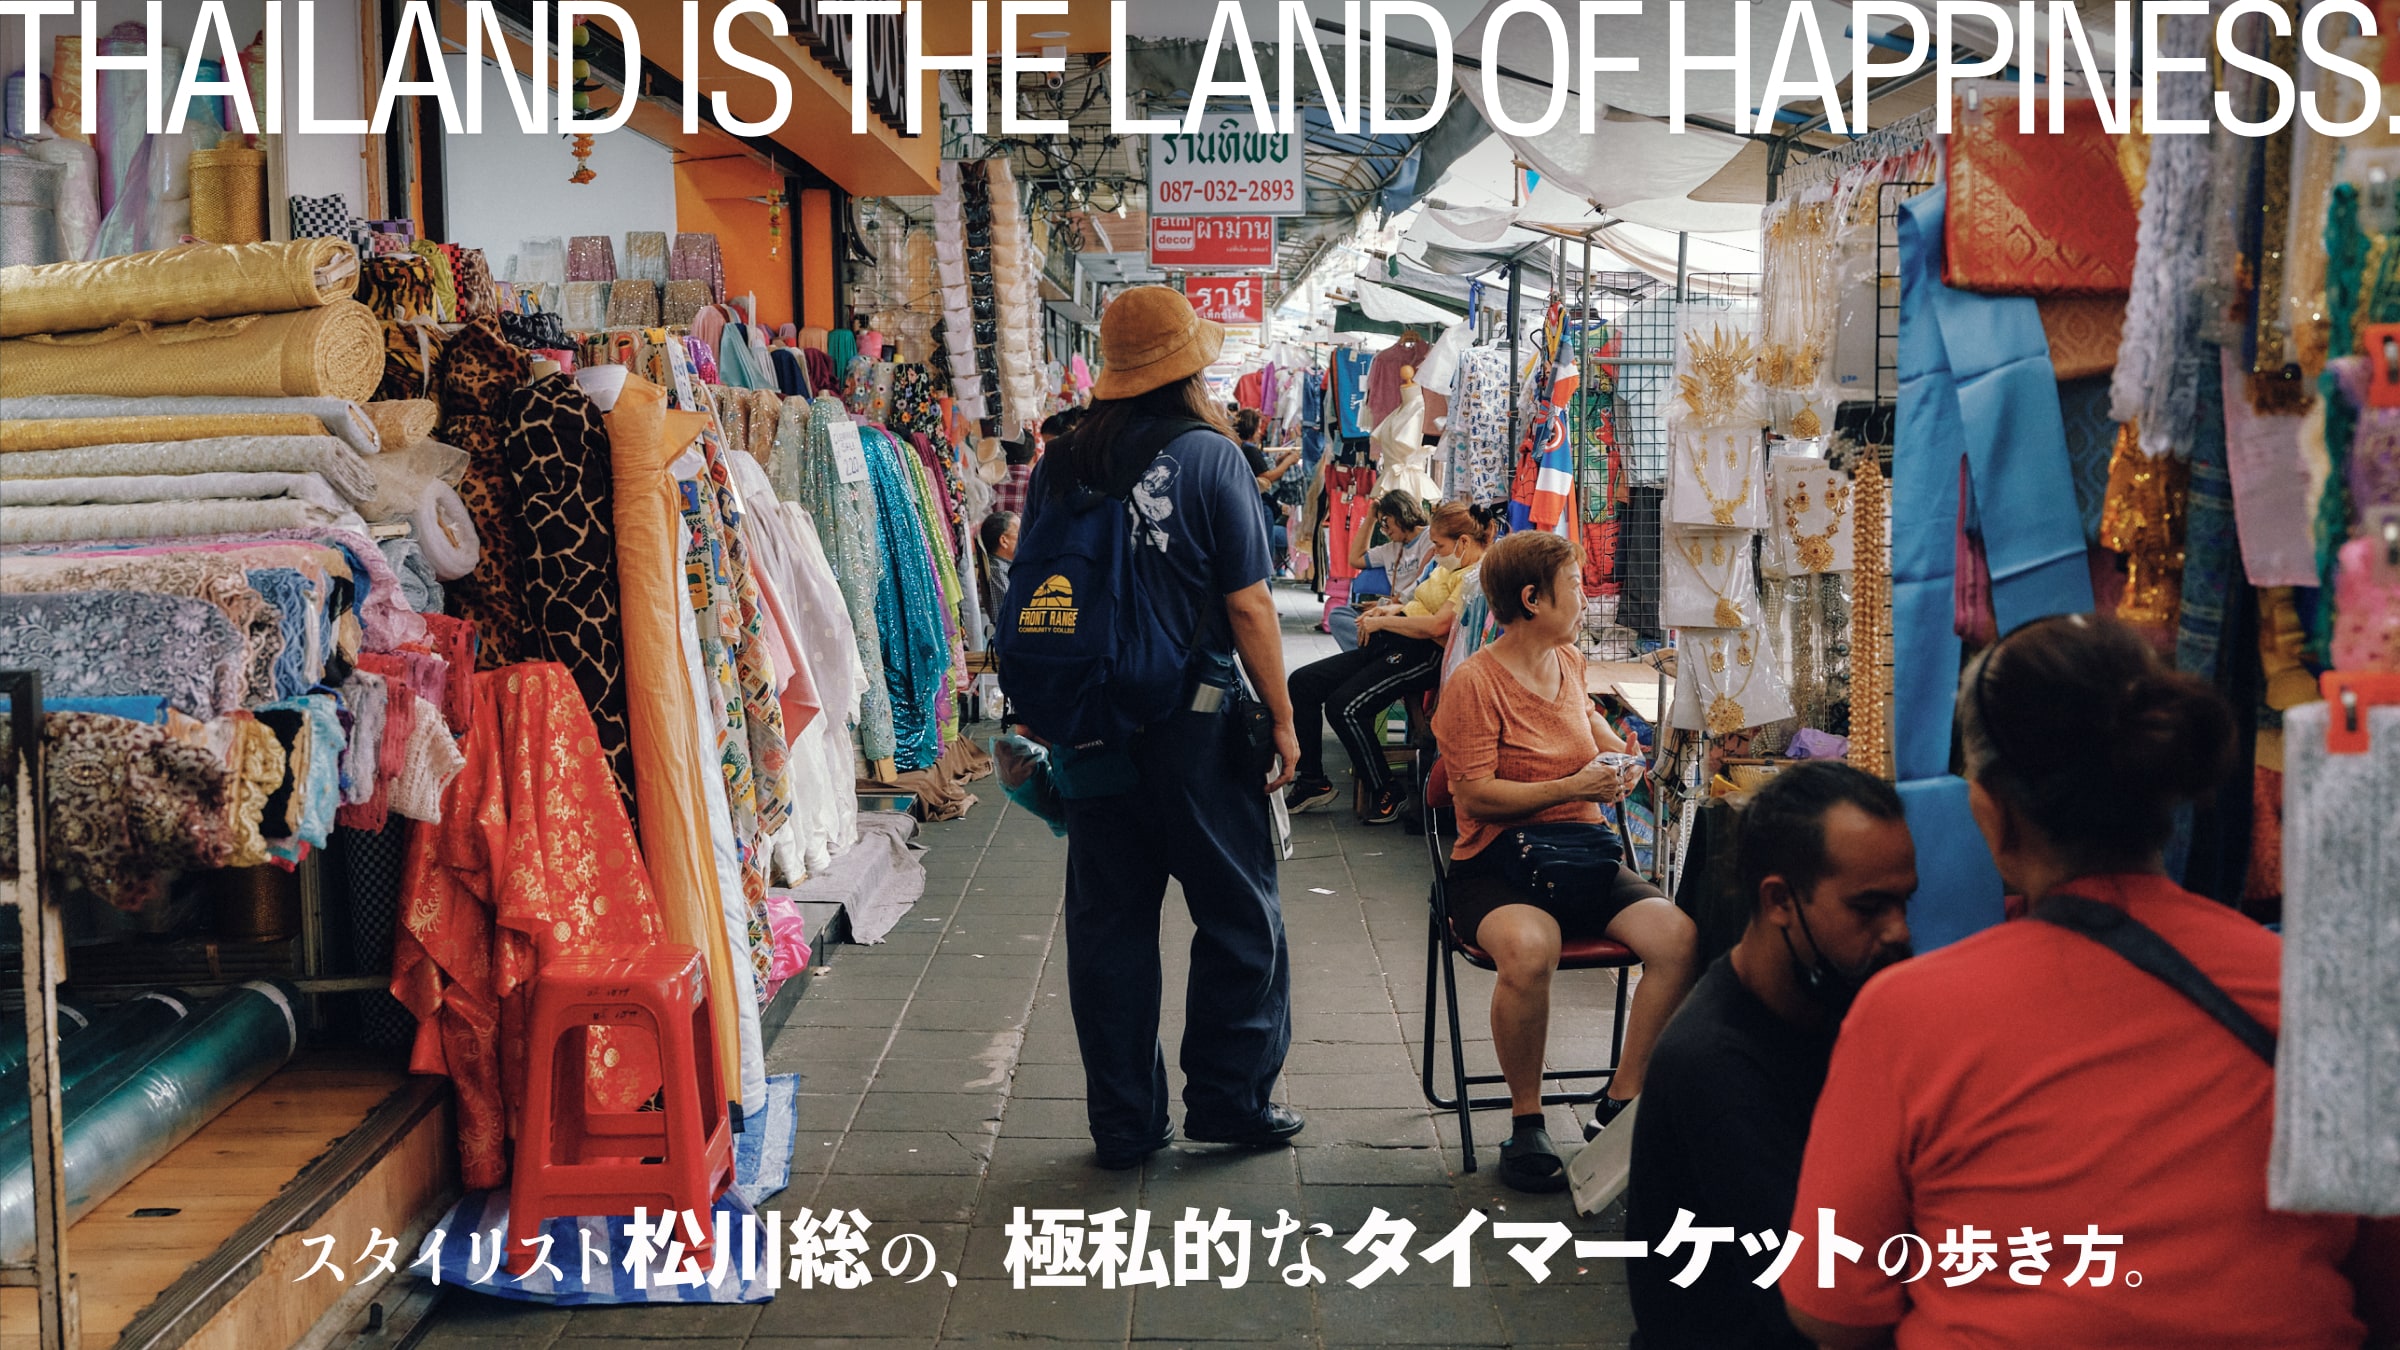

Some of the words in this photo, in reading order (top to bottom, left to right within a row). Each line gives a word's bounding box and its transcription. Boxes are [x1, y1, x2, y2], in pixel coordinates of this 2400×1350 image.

[1159, 178, 1295, 203] 087-032-2893
[1158, 234, 1192, 245] decor
[1197, 216, 1269, 240] ผาม่าน
[1196, 279, 1252, 307] รานี
[1019, 610, 1047, 626] FRONT
[1050, 611, 1078, 626] RANGE
